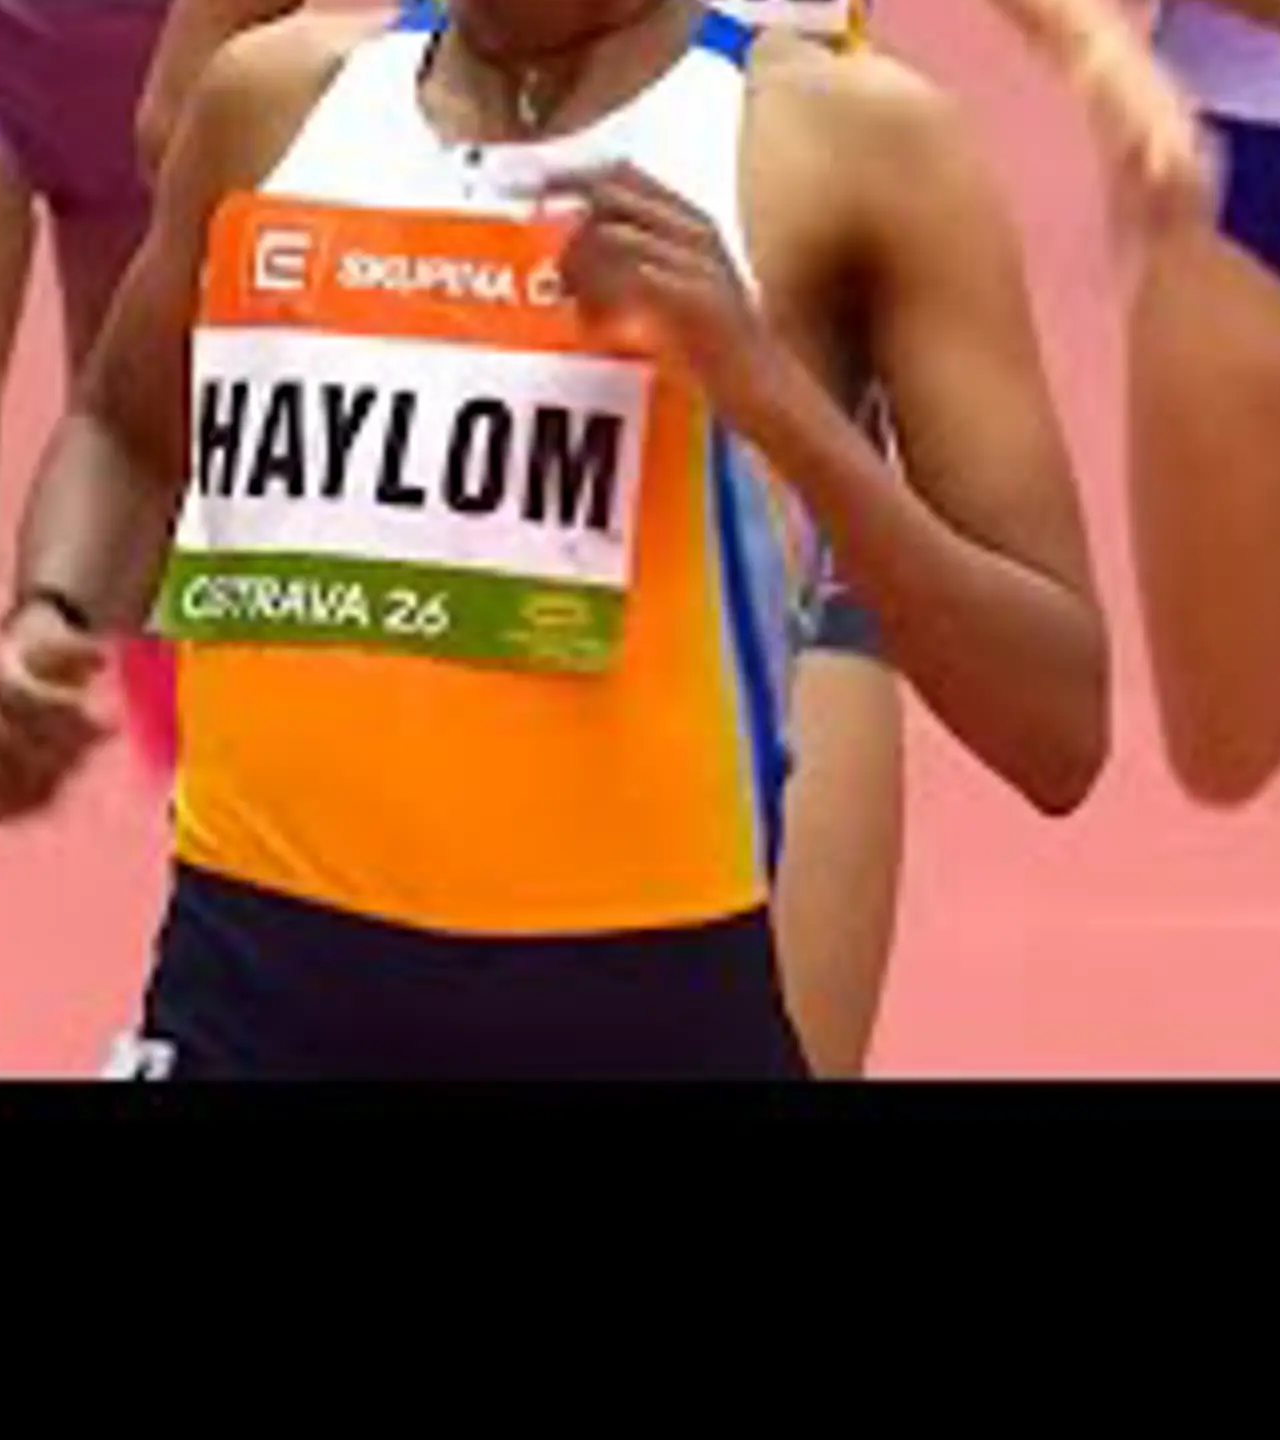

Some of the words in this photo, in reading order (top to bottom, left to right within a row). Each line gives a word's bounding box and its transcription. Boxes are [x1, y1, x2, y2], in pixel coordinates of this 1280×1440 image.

[336, 248, 518, 306] SKUPINA
[198, 378, 625, 531] HAYLOM
[181, 573, 370, 629] OSTRAVA
[382, 584, 451, 638] 26
